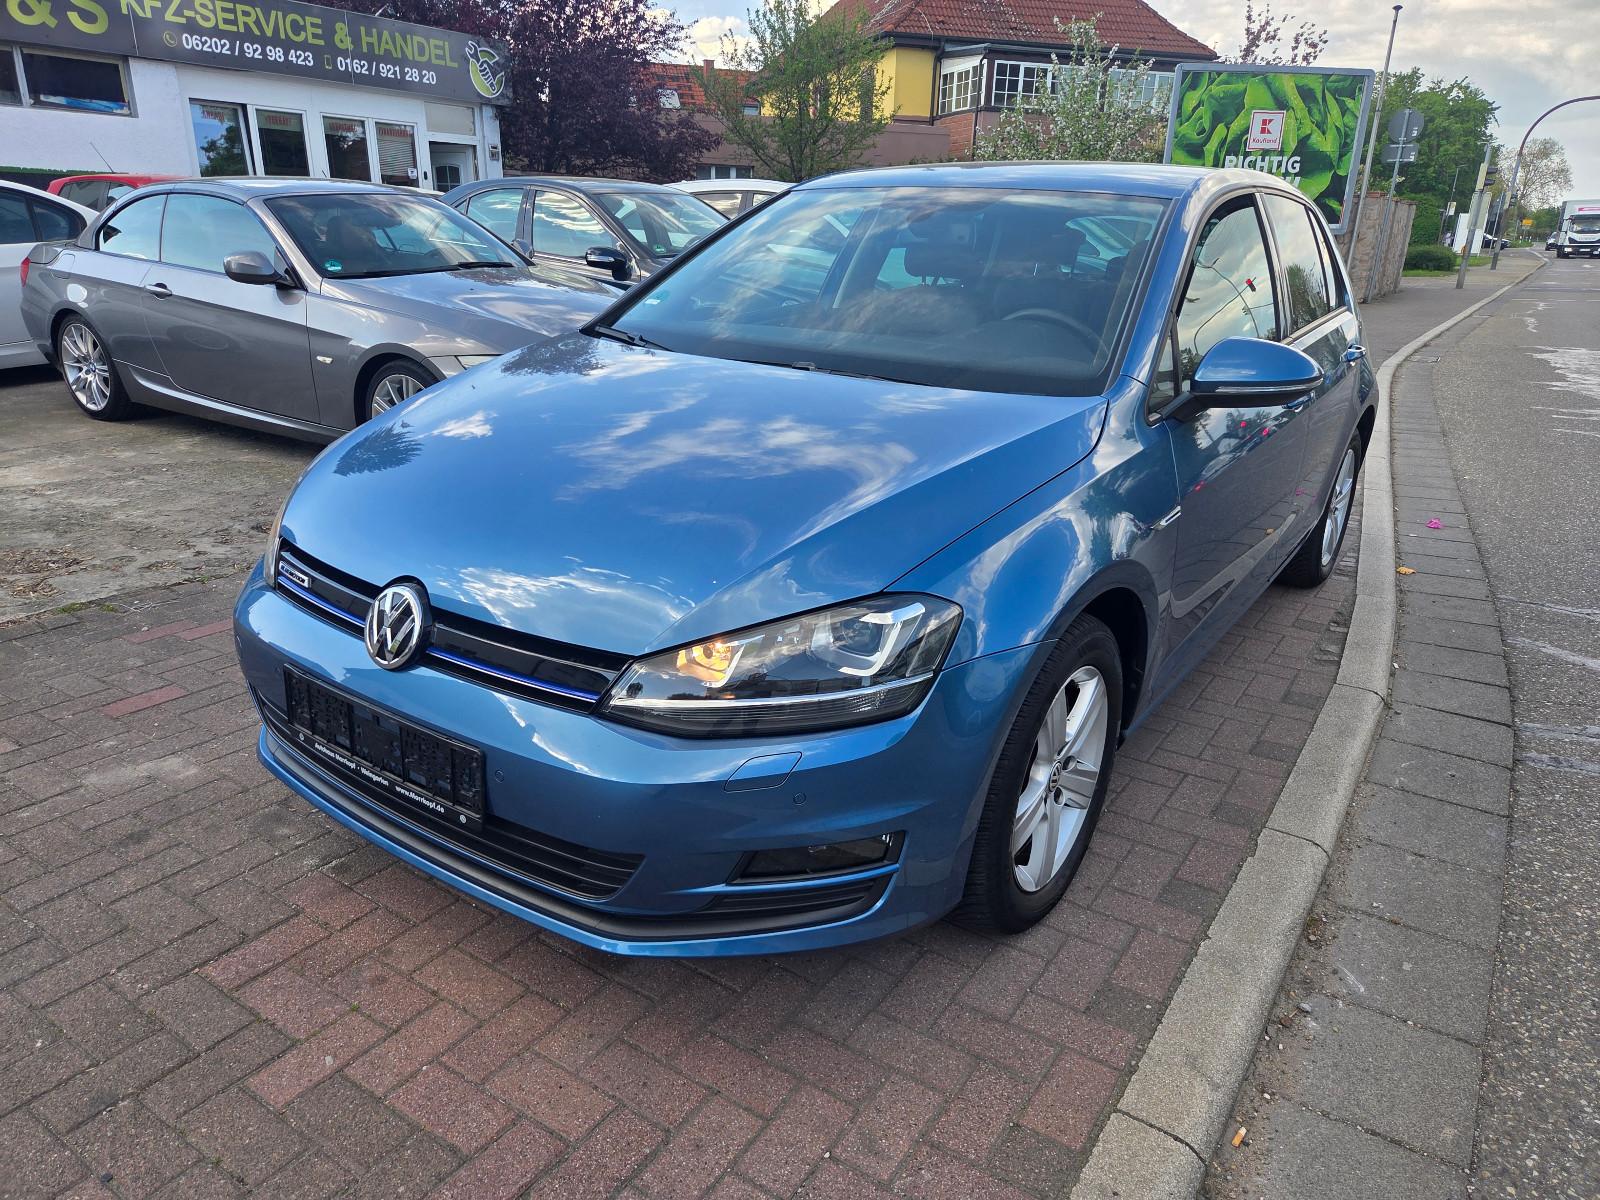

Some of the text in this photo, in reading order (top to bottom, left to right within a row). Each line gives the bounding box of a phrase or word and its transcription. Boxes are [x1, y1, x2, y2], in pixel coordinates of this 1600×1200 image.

[182, 33, 314, 67] 06202 / 92 98 423
[334, 22, 355, 51] &
[360, 26, 459, 68] HANDEL
[337, 57, 437, 85] 0162 / 921 28 20
[1224, 155, 1301, 174] RICHTIG
